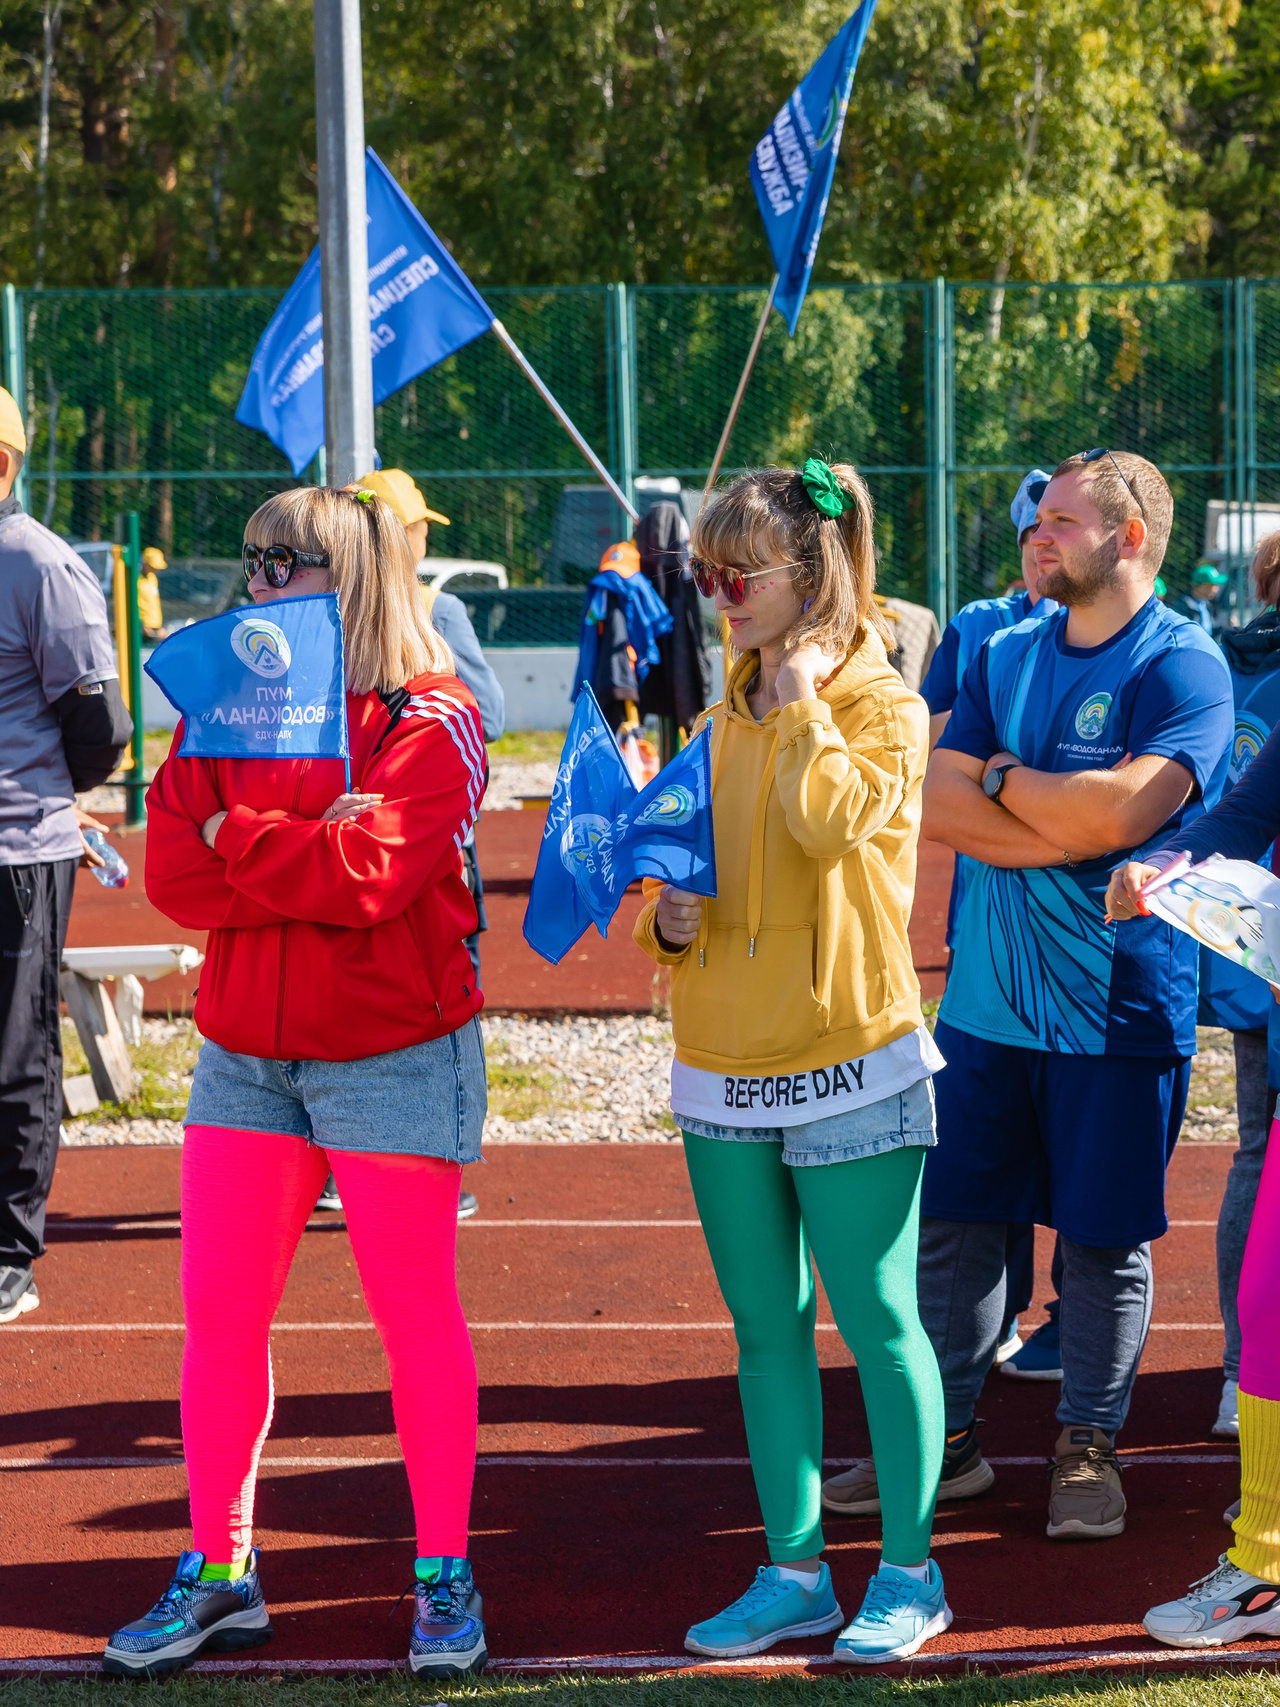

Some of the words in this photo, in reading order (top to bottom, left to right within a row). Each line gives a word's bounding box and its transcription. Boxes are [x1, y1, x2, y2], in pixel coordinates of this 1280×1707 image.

[756, 134, 794, 217] СЛУЖБА
[724, 1073, 808, 1109] BEFORE
[812, 1058, 864, 1100] DAY
